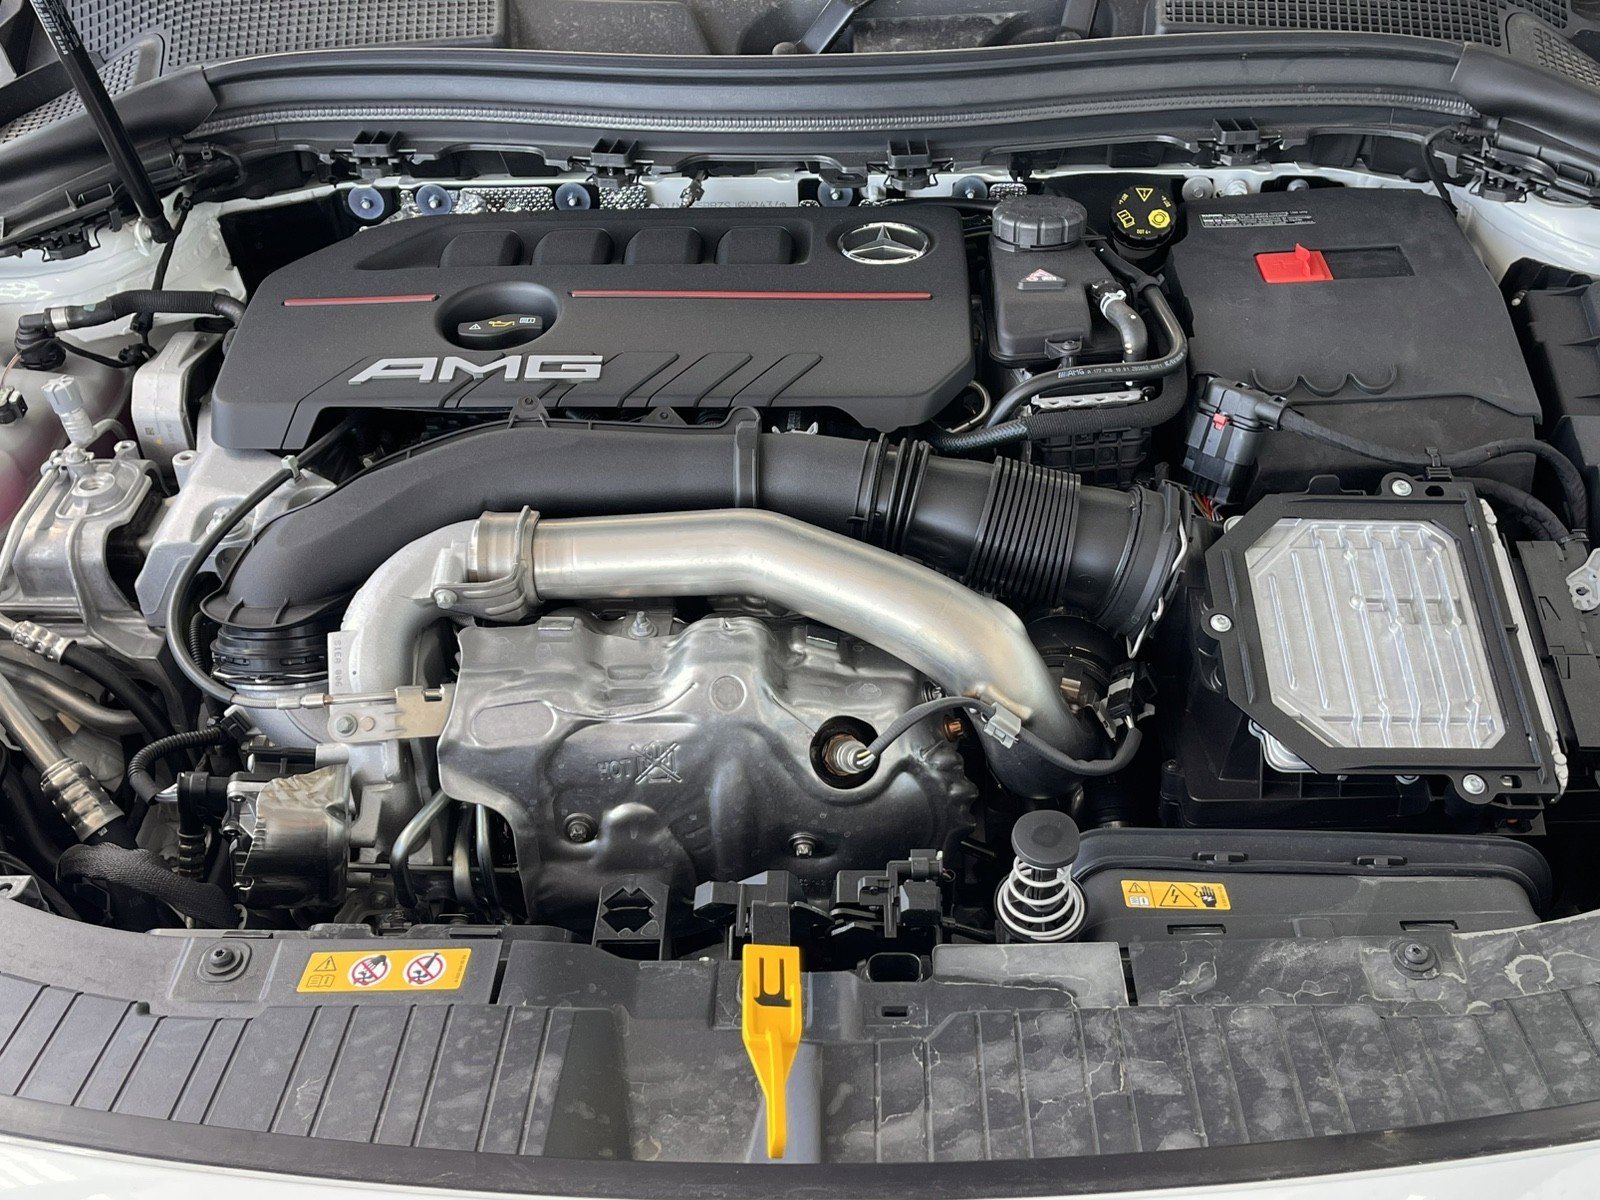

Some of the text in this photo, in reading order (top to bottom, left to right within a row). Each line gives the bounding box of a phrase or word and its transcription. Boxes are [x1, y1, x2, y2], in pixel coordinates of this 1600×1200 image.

[347, 355, 604, 385] AMG
[1067, 368, 1085, 377] AMG
[597, 758, 632, 782] HOT
